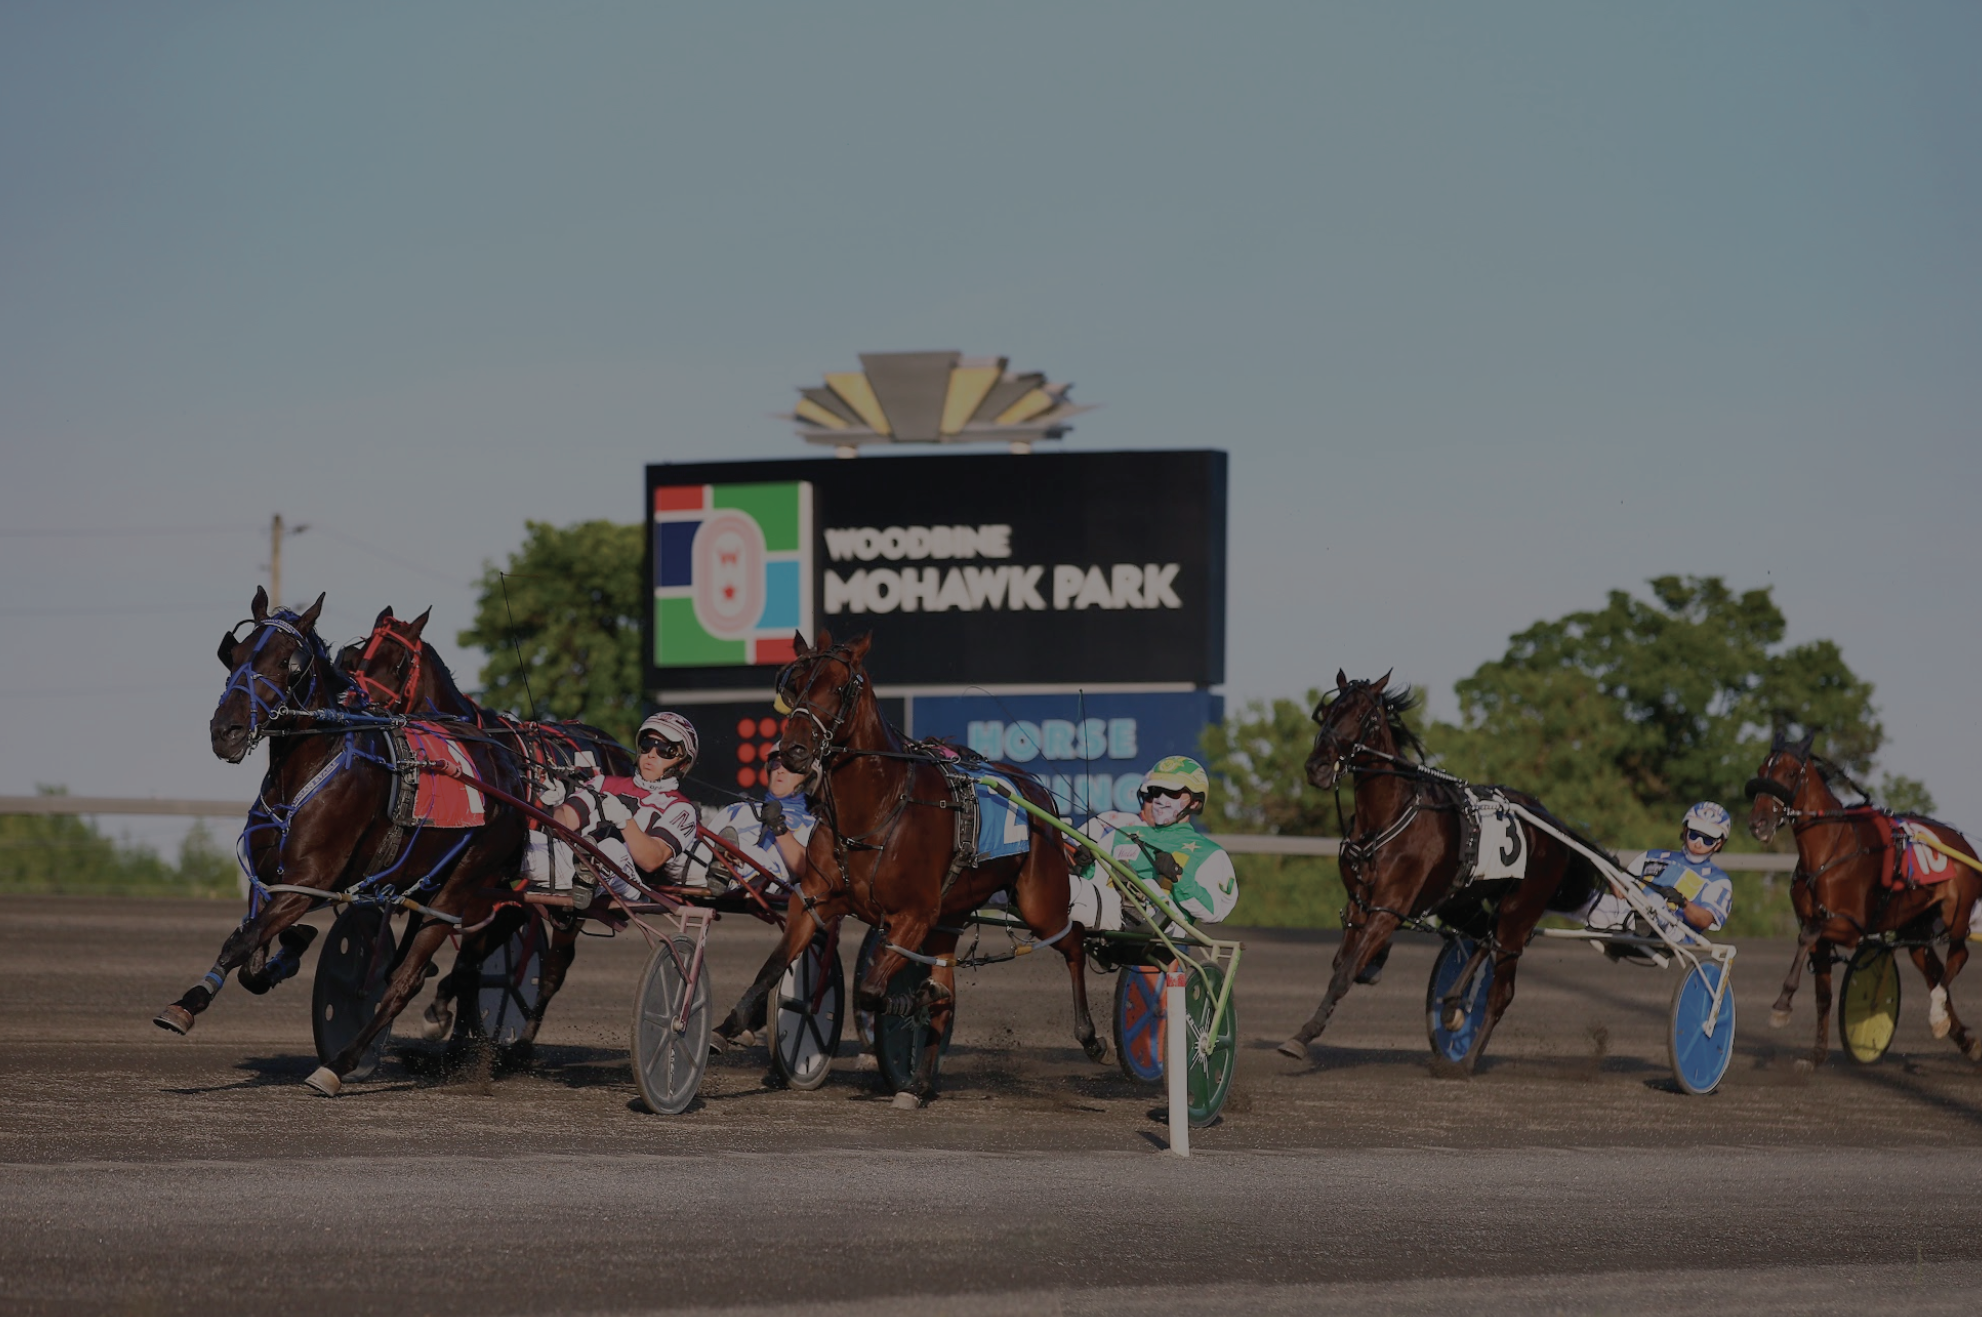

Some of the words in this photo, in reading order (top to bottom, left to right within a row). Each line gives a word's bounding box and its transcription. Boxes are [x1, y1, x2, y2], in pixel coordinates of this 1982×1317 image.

[823, 524, 1012, 561] WOODBINE
[823, 564, 1047, 614] MOHAWK
[1053, 563, 1182, 610] PARK
[968, 718, 1138, 762] HORSE
[671, 809, 696, 839] M
[985, 774, 1030, 845] 2
[1496, 809, 1522, 867] 3
[1900, 822, 1948, 875] 10
